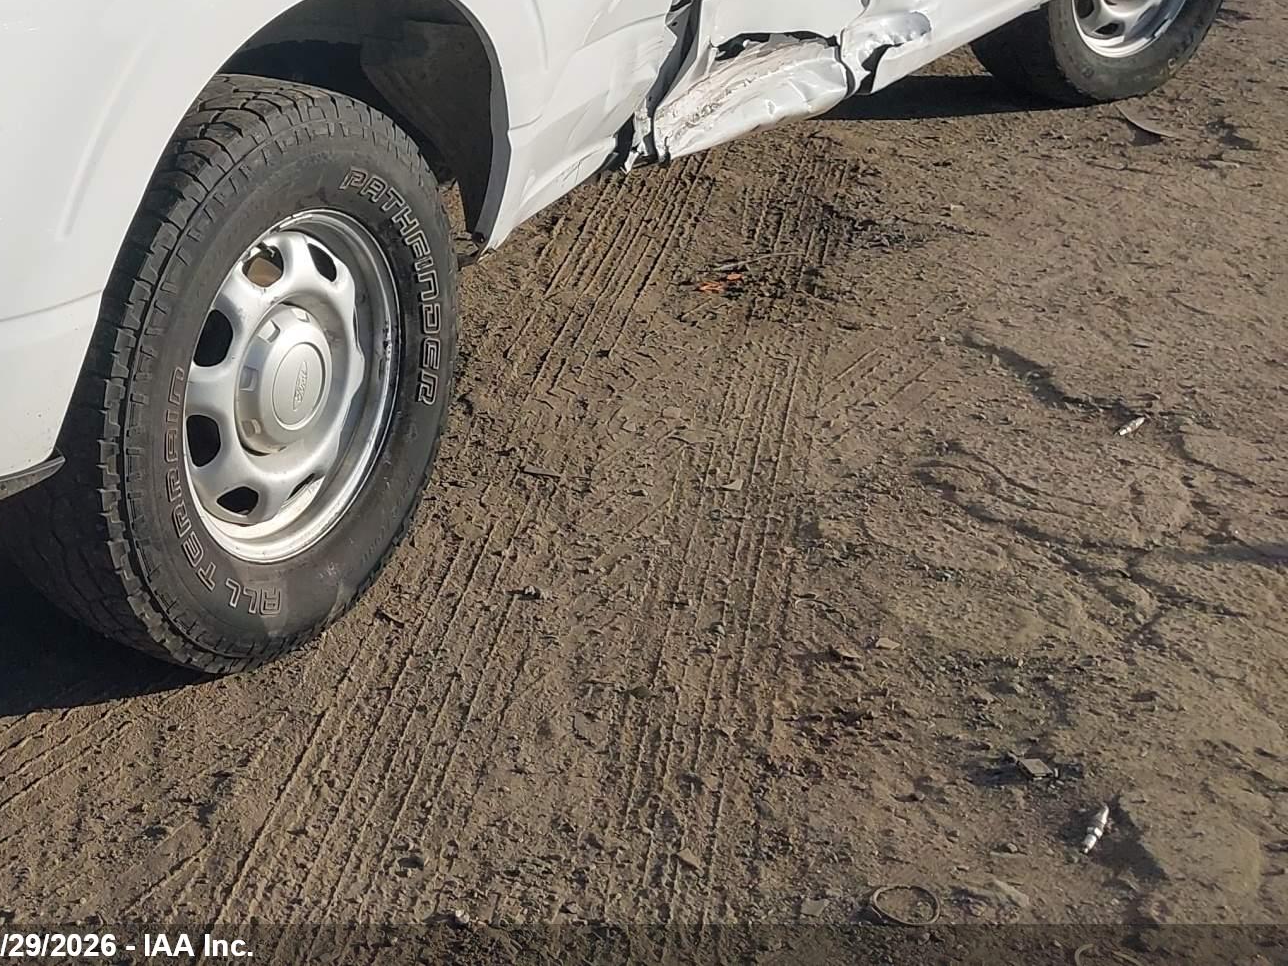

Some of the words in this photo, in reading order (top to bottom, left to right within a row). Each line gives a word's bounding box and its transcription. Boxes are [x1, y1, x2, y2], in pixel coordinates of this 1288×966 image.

[339, 166, 442, 407] PATHFINDER
[164, 365, 216, 592] TERRAIN
[224, 577, 282, 616] ALL
